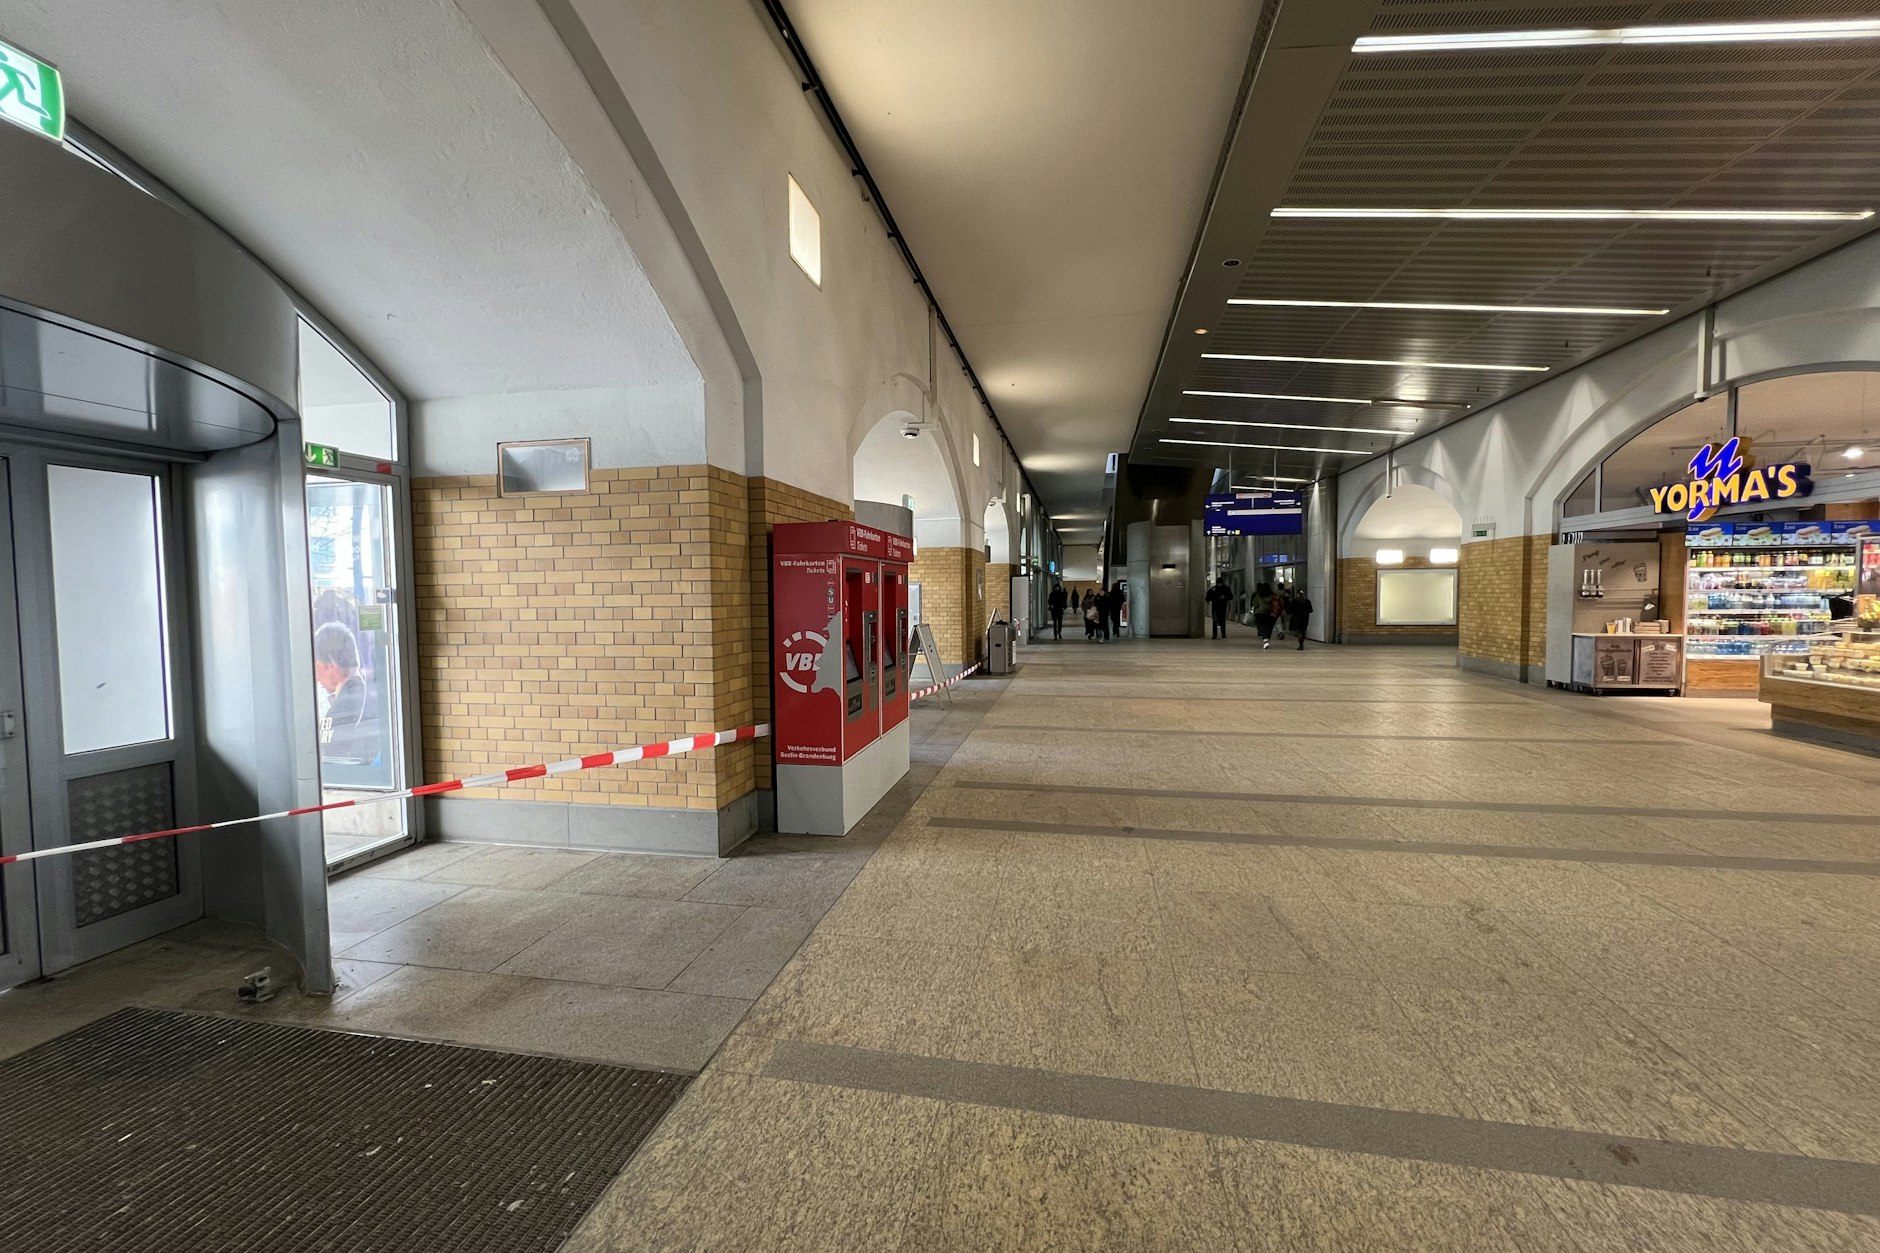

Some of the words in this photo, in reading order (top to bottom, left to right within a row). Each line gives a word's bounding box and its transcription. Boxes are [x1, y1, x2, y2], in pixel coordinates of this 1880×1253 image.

[1649, 464, 1798, 514] YORMA'S
[787, 744, 837, 753] Verkehrsverbund
[780, 751, 837, 761] Berlin-Brandenburg
